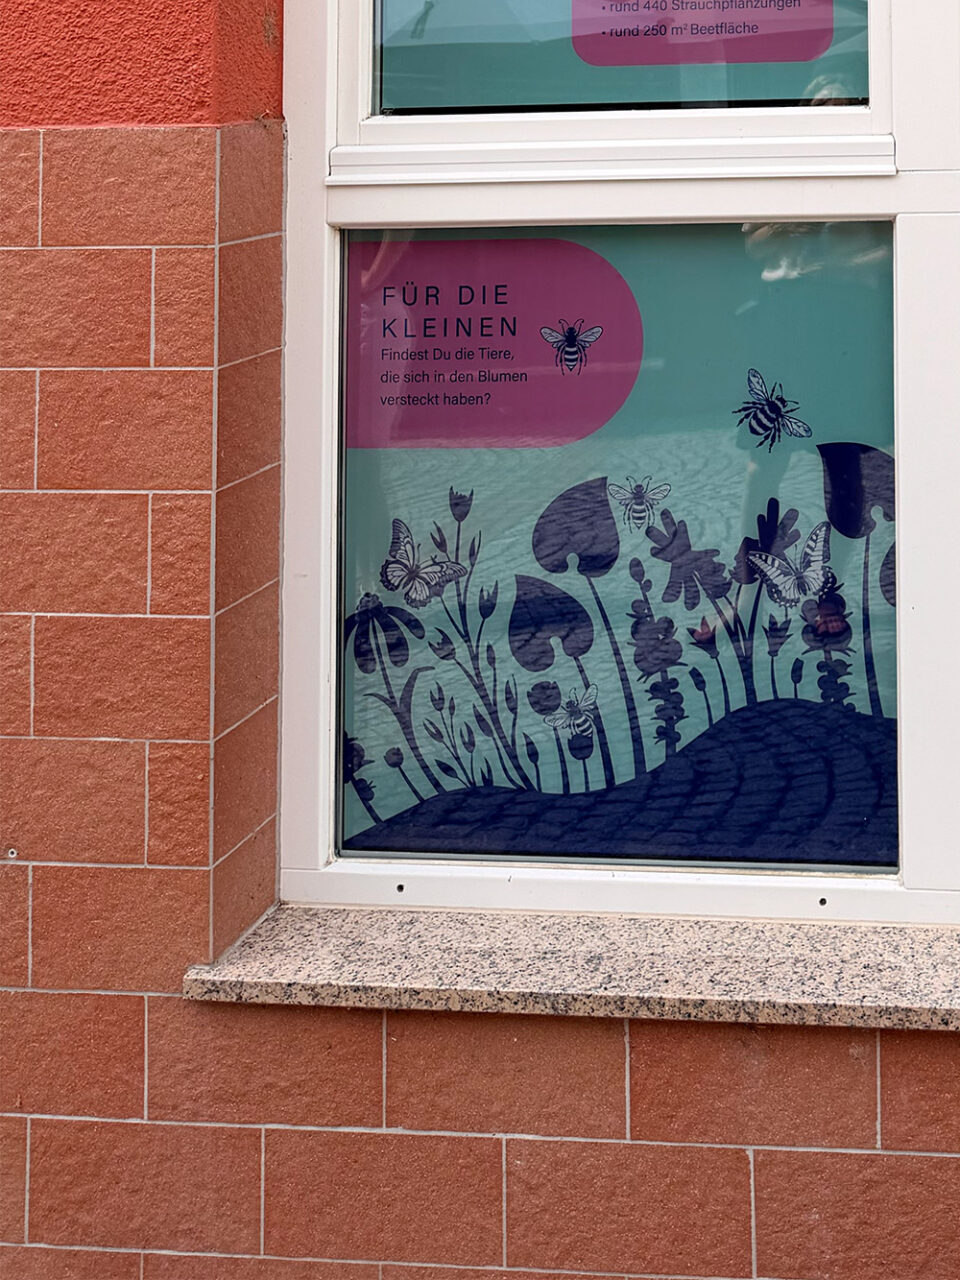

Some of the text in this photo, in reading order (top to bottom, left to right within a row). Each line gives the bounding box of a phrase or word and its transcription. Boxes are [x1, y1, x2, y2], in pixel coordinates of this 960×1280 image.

[610, 0, 639, 12] rund
[643, 0, 667, 11] 440
[610, 25, 639, 37] rund
[643, 25, 666, 36] 250
[690, 21, 758, 35] Beetfläche
[383, 281, 508, 306] FÜR DIE
[382, 317, 517, 338] KLEINEN
[381, 347, 514, 360] Findest Du die Tiere,
[380, 370, 528, 383] die sich in den Blumen
[380, 393, 491, 405] versteckt haben?
